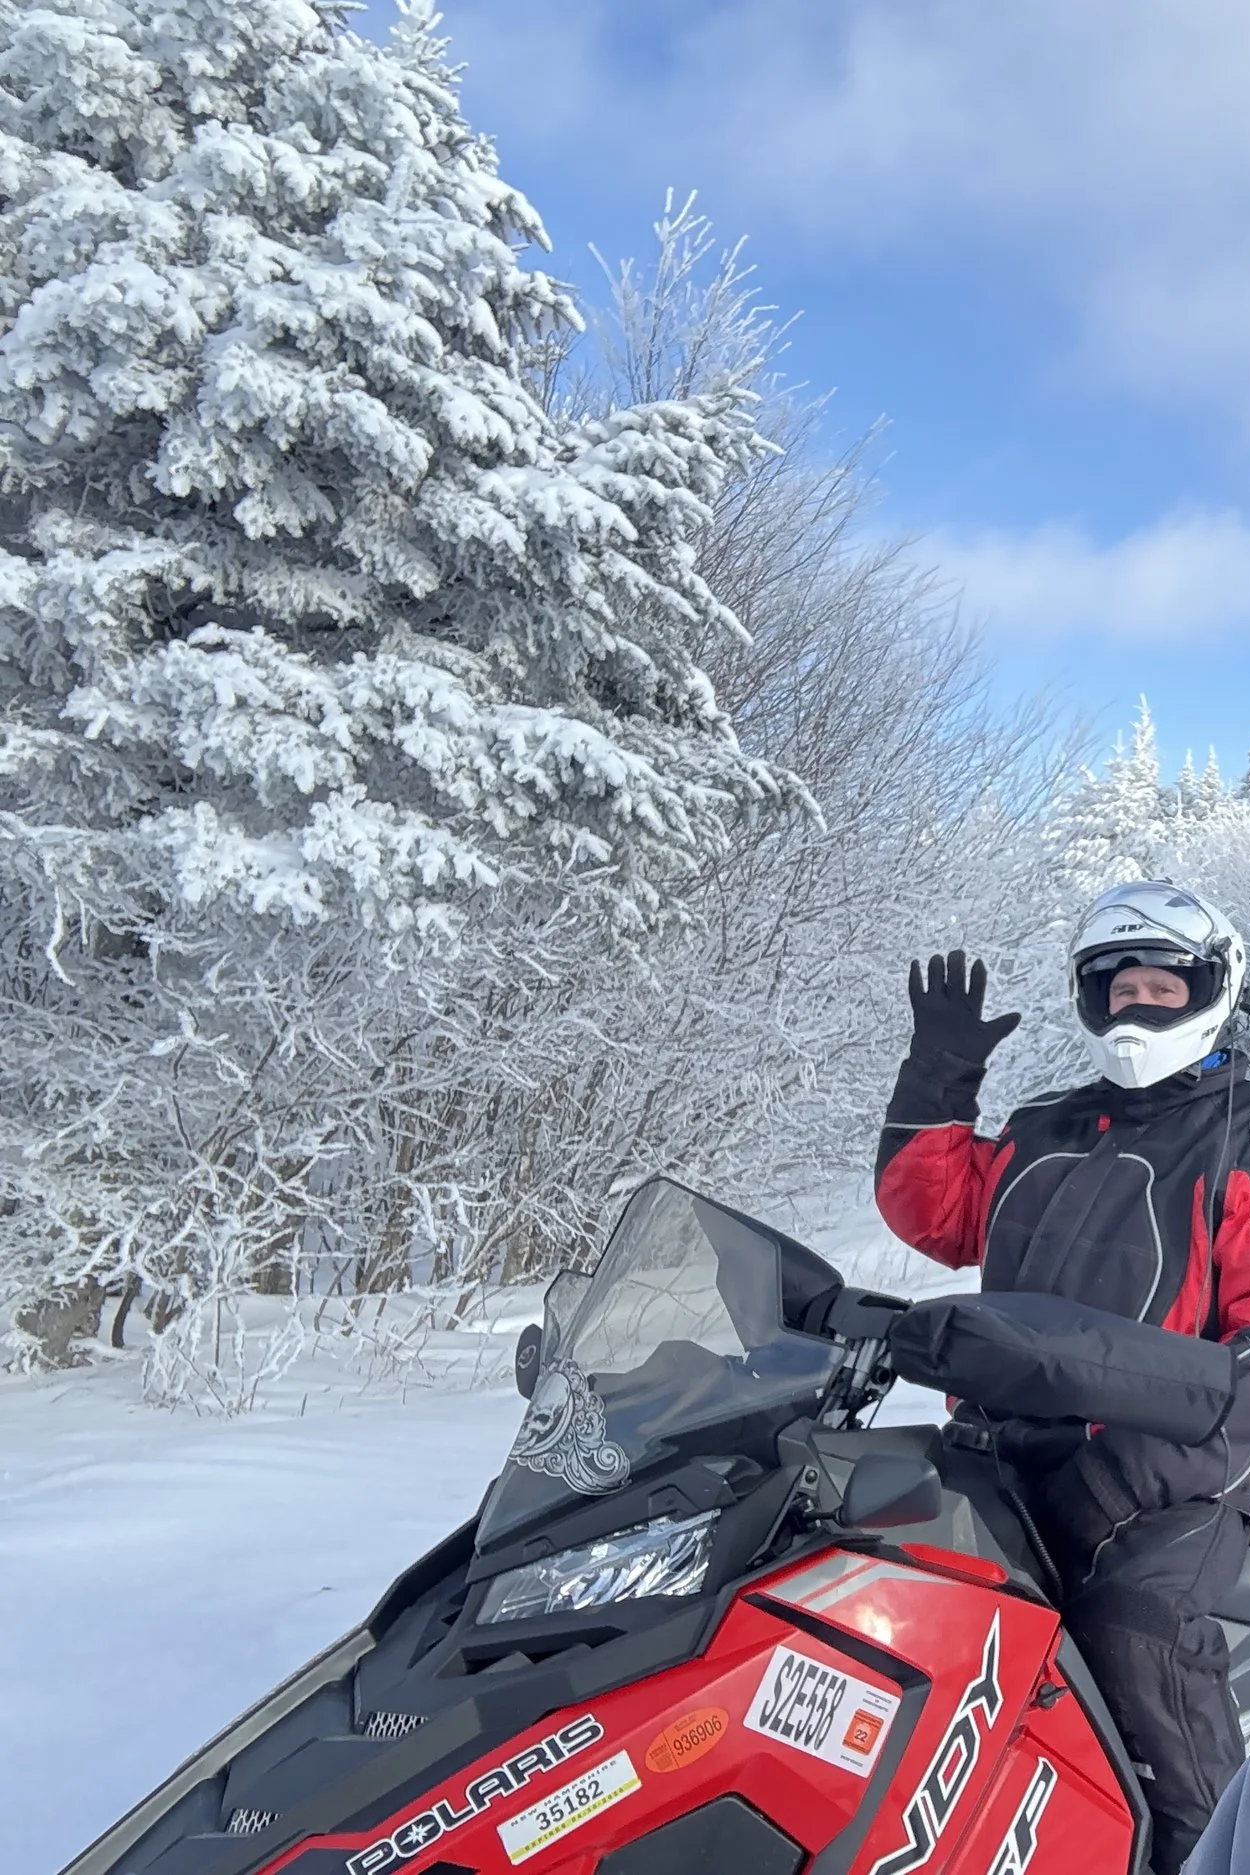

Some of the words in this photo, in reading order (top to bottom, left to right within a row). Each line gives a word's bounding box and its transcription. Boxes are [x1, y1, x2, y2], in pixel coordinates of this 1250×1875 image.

[759, 1654, 847, 1751] S2E558
[673, 1715, 722, 1756] 936906
[854, 1729, 868, 1743] 22
[345, 1713, 604, 1875] POLARIS
[535, 1780, 604, 1830] 35182
